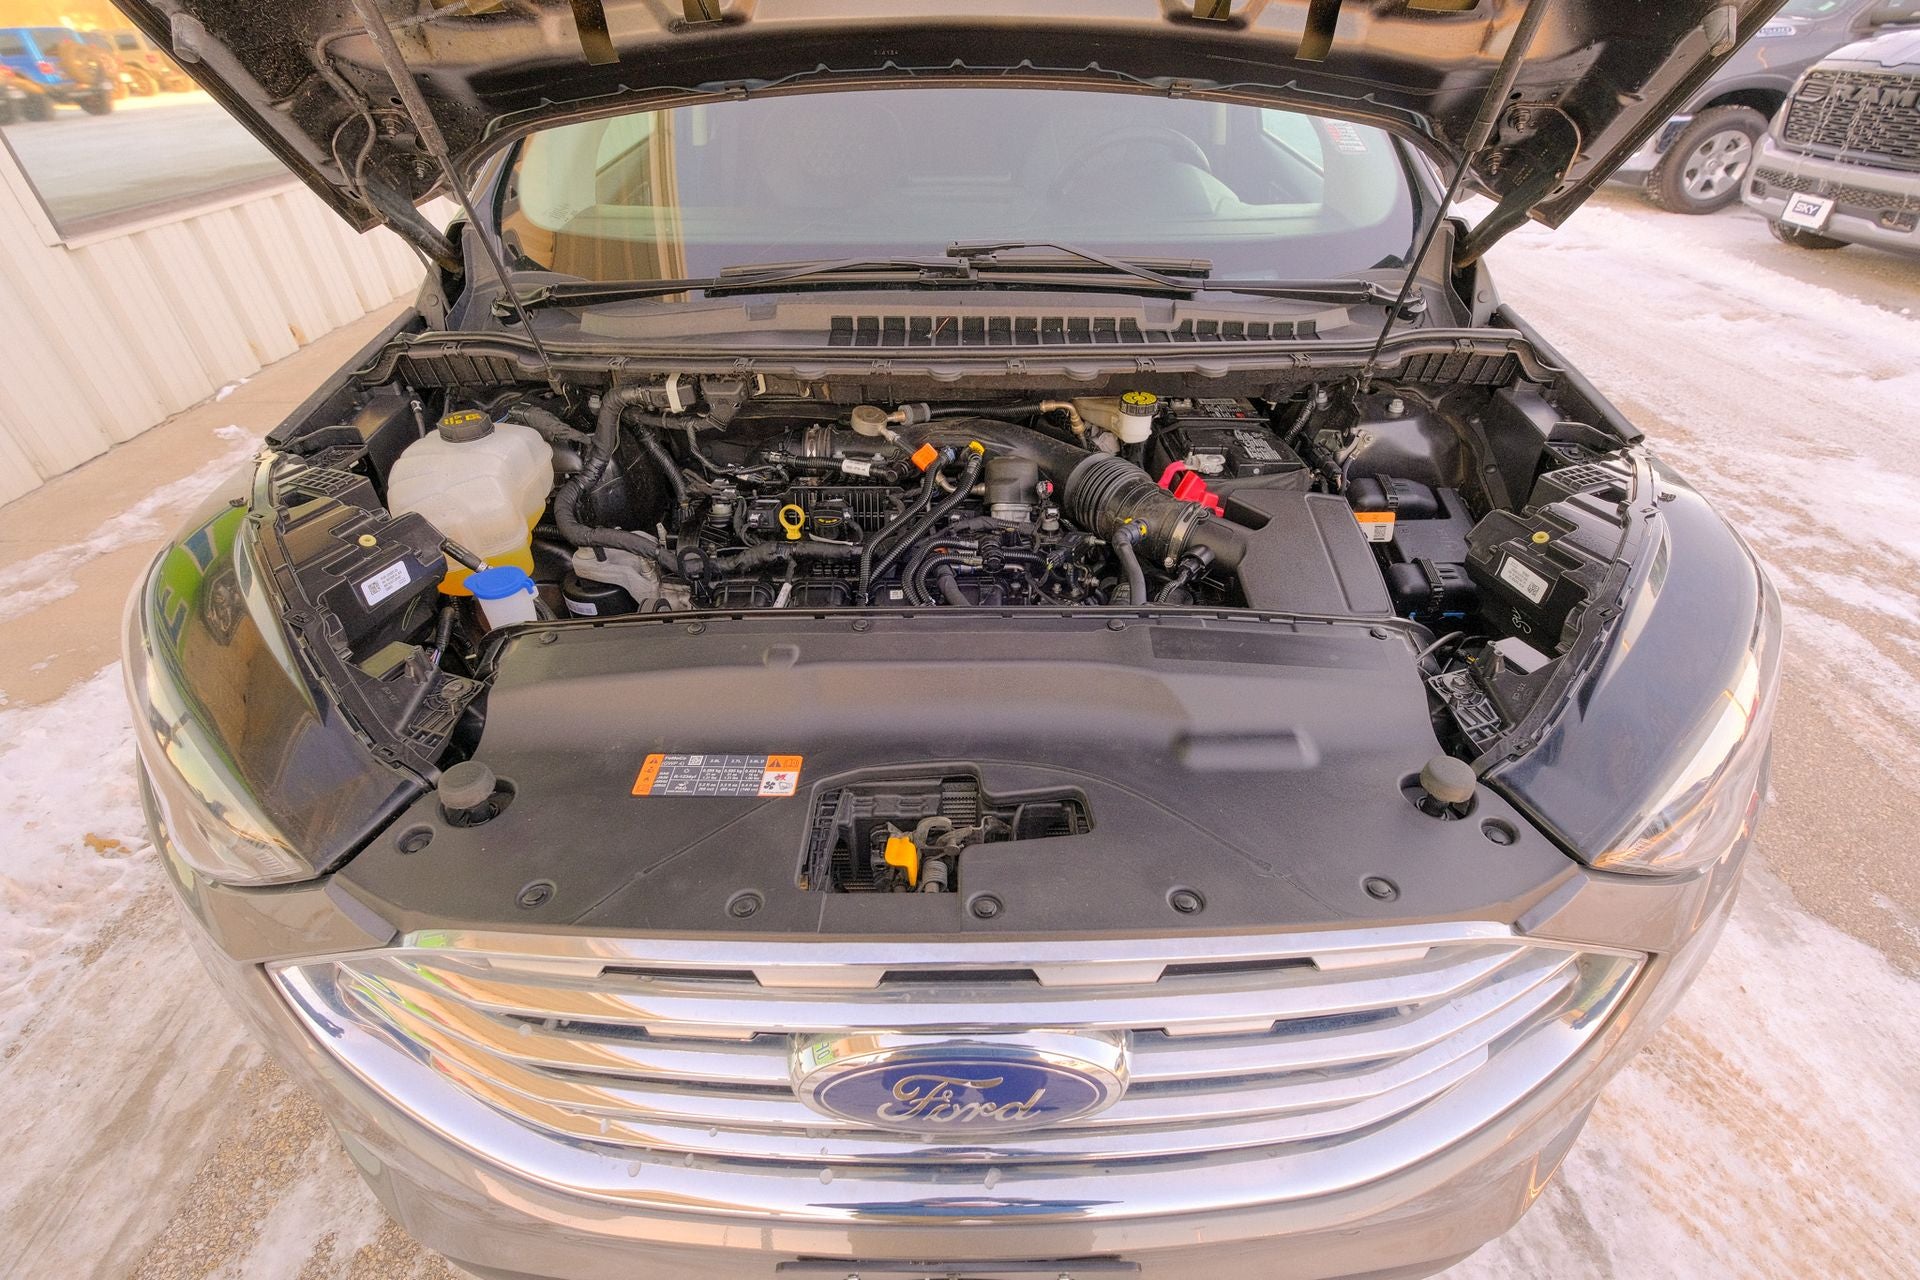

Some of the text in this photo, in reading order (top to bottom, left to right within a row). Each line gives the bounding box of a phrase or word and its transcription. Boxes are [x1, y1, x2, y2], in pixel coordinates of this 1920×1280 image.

[1829, 83, 1917, 107] RAM
[1795, 203, 1818, 214] SKY
[876, 1074, 1047, 1123] Ford
